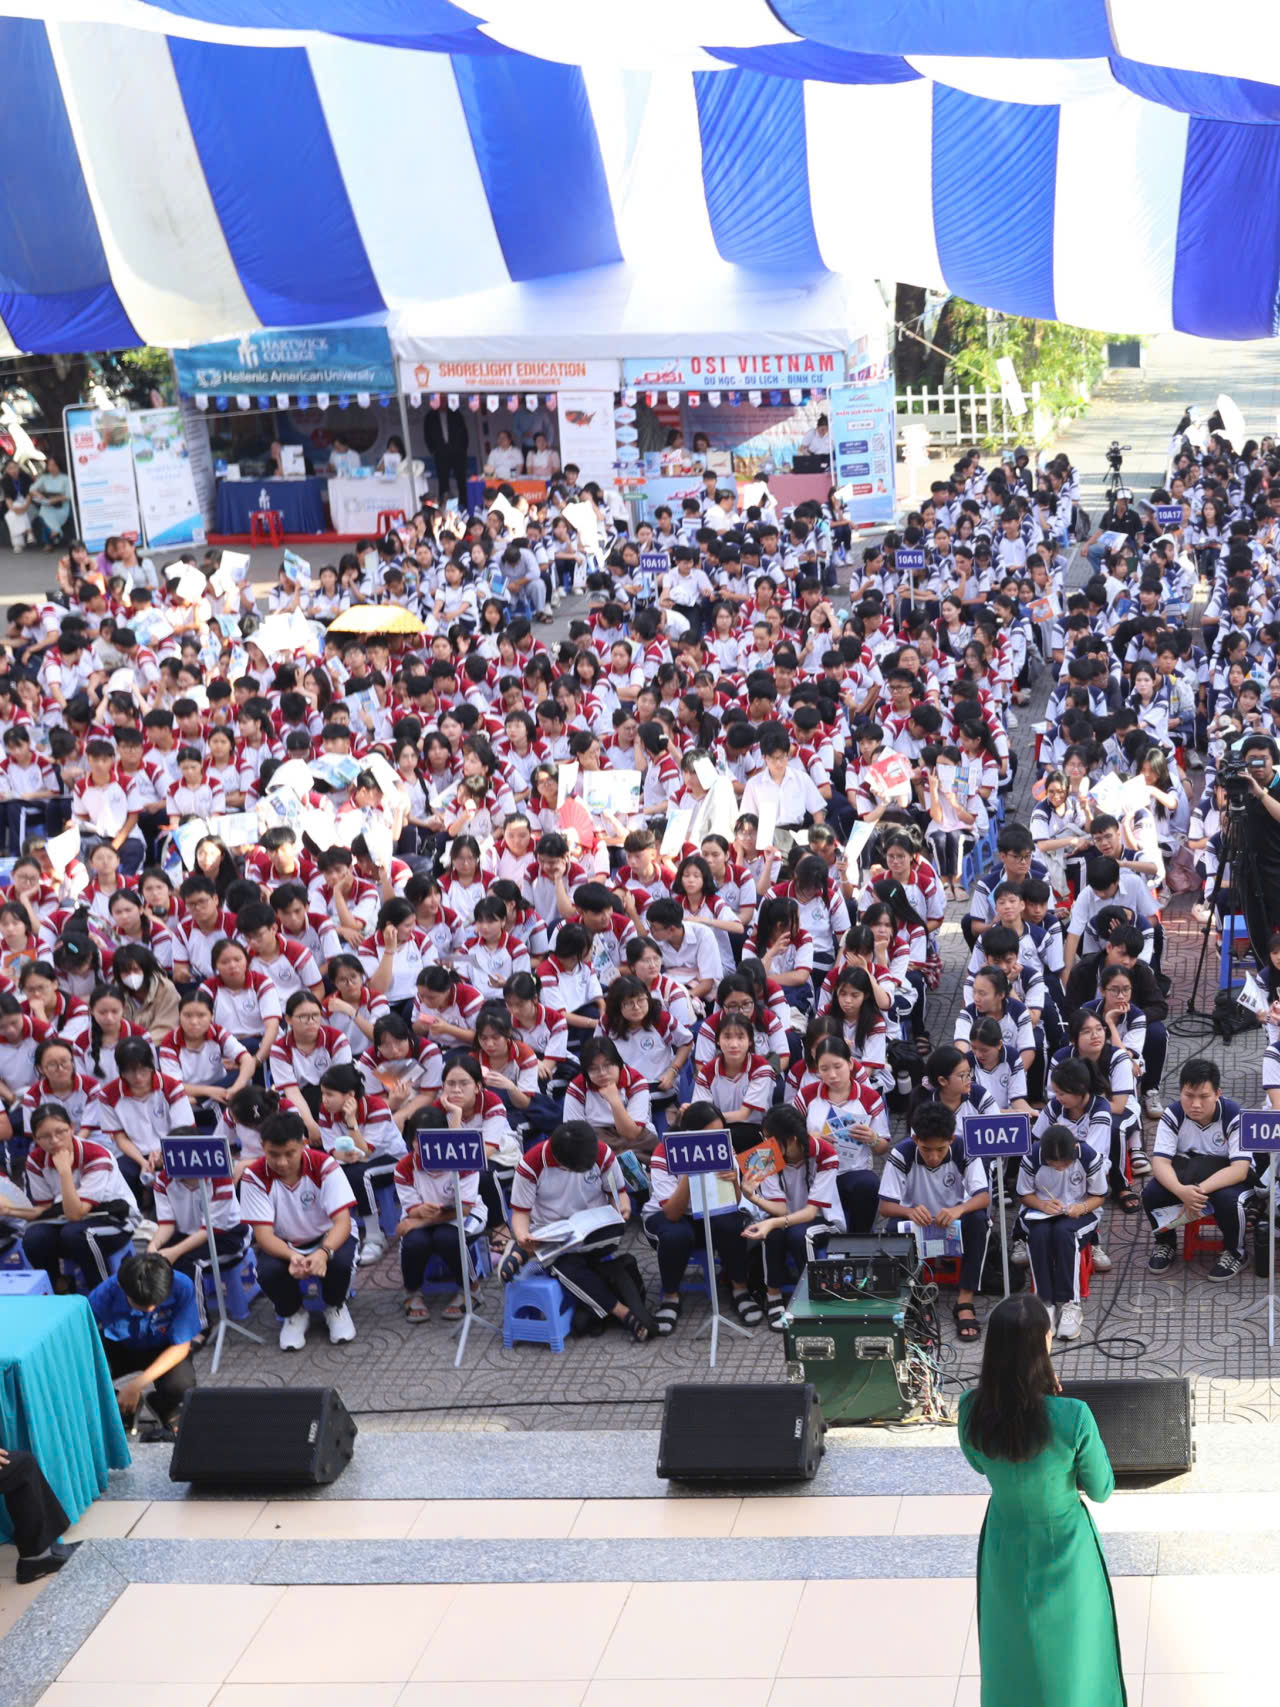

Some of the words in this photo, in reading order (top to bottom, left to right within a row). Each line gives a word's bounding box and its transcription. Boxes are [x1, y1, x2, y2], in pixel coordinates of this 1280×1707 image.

[261, 338, 328, 350] HARTWICK
[263, 350, 316, 362] COLLEGE
[439, 361, 513, 377] SHORELIGHT
[517, 361, 587, 377] EDUCATION
[691, 356, 726, 375] OSI
[738, 354, 834, 374] VIETNAM
[224, 370, 269, 383] Hellenic
[271, 371, 323, 383] American
[324, 369, 375, 383] University
[704, 376, 715, 385] DU
[718, 376, 736, 386] HỌC
[745, 376, 756, 385] DU
[1159, 510, 1182, 520] 10A17
[642, 558, 666, 569] 10A19
[898, 554, 923, 565] 10A18
[974, 1127, 1020, 1145] 10A7
[166, 1149, 225, 1168] 11A16
[423, 1142, 480, 1161] 11A17
[669, 1143, 728, 1163] 11A18
[794, 1418, 803, 1438] NEXO
